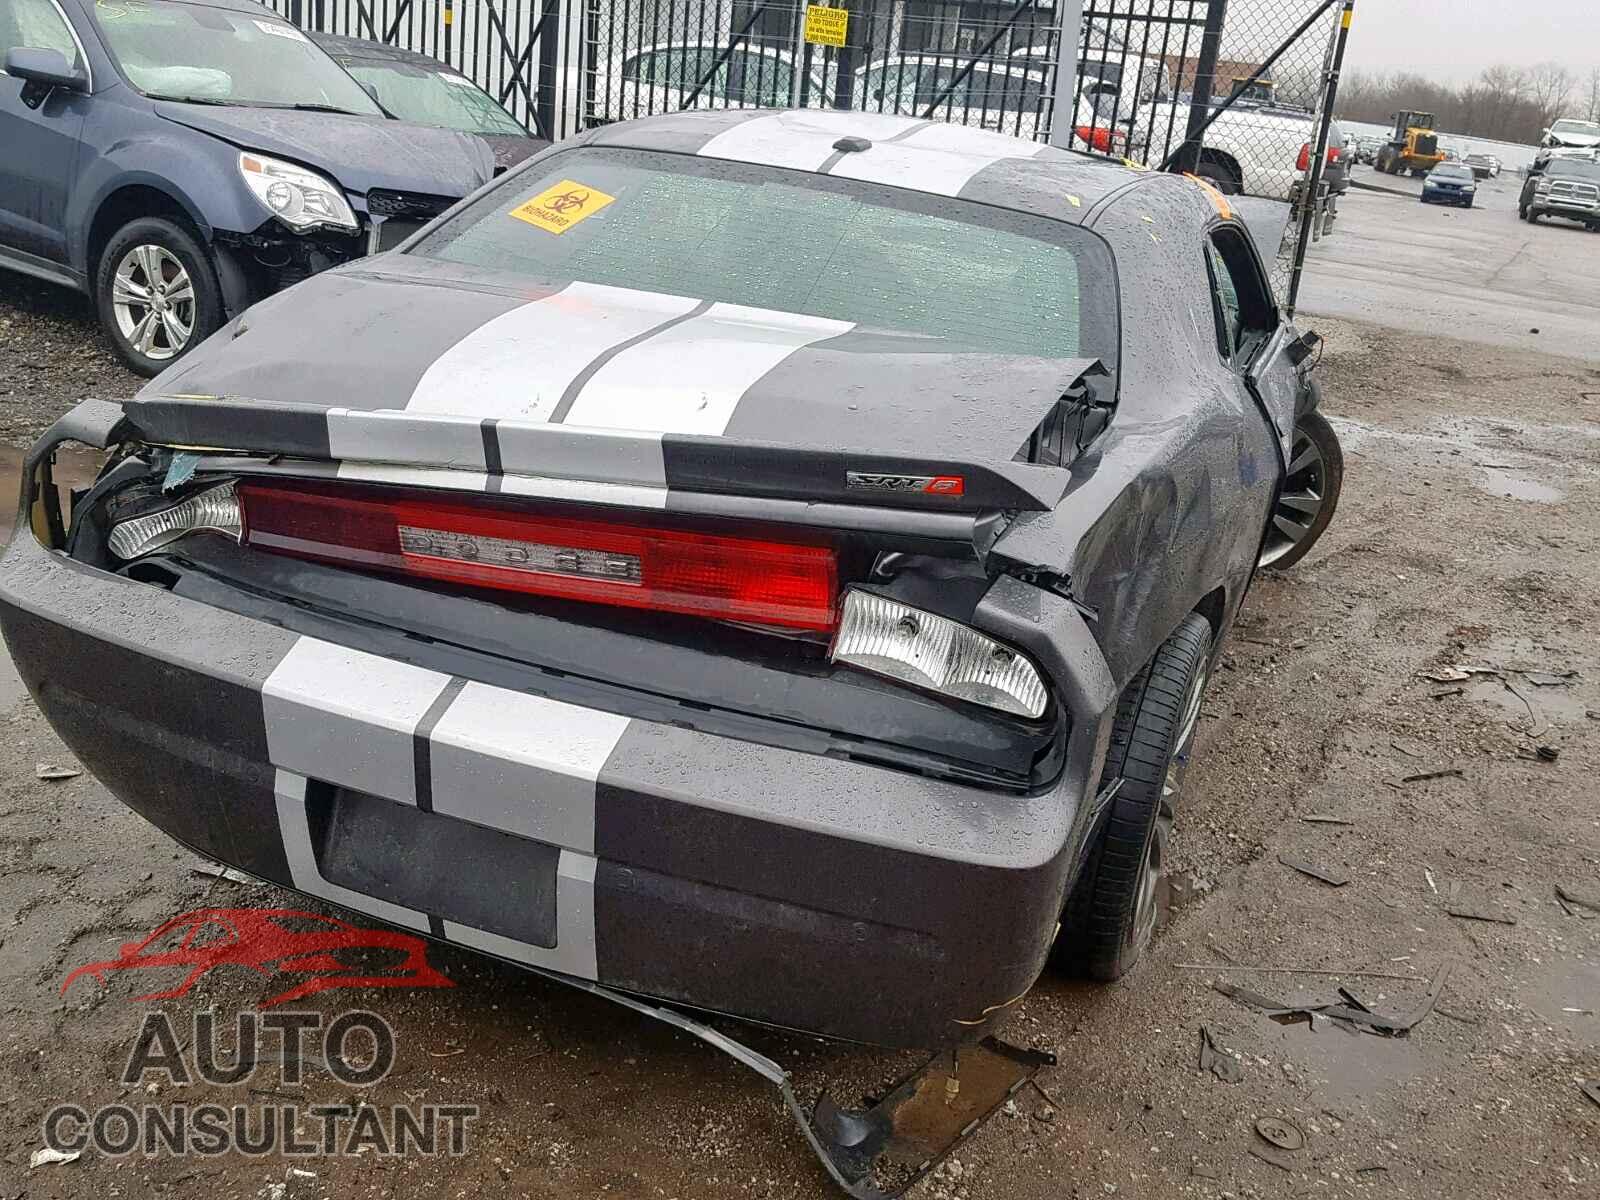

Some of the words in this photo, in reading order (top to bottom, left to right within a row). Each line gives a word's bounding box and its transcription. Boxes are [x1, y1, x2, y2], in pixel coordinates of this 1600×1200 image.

[809, 8, 846, 20] PELIGRO
[521, 204, 569, 227] BIOHAZARD
[411, 534, 632, 578] DODGE
